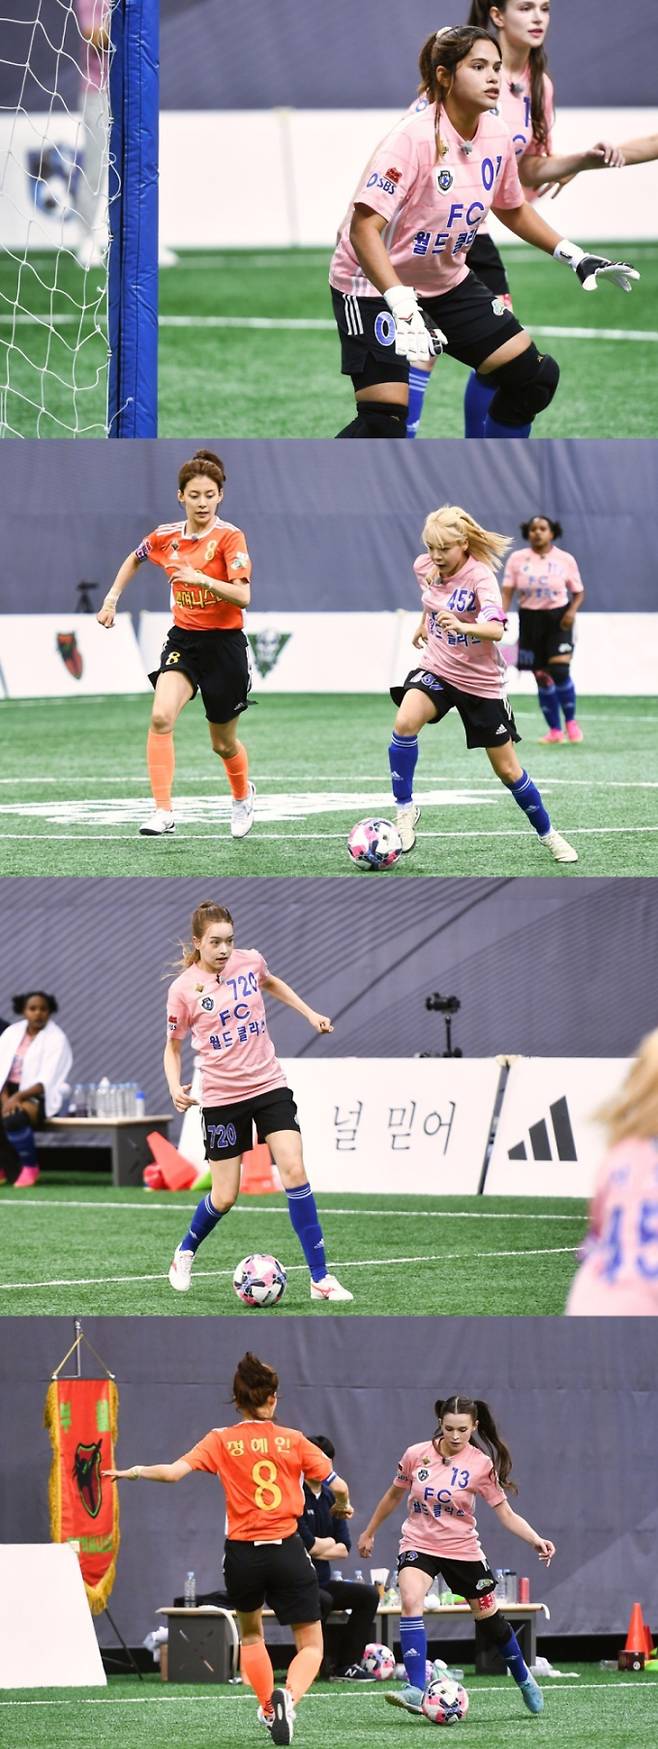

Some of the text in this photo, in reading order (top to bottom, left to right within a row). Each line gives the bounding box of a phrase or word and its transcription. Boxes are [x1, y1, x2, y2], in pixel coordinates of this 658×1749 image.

[377, 178, 395, 195] SBS
[447, 202, 485, 228] FC
[204, 540, 217, 561] 8
[448, 588, 477, 611] 452
[165, 651, 181, 666] 8
[227, 972, 258, 1000] 720
[219, 1003, 250, 1026] FC
[208, 1123, 236, 1149] 720
[334, 1100, 457, 1155] 널 믿어
[252, 1459, 282, 1511] 8
[451, 1467, 470, 1489] 13
[424, 1487, 452, 1504] FC
